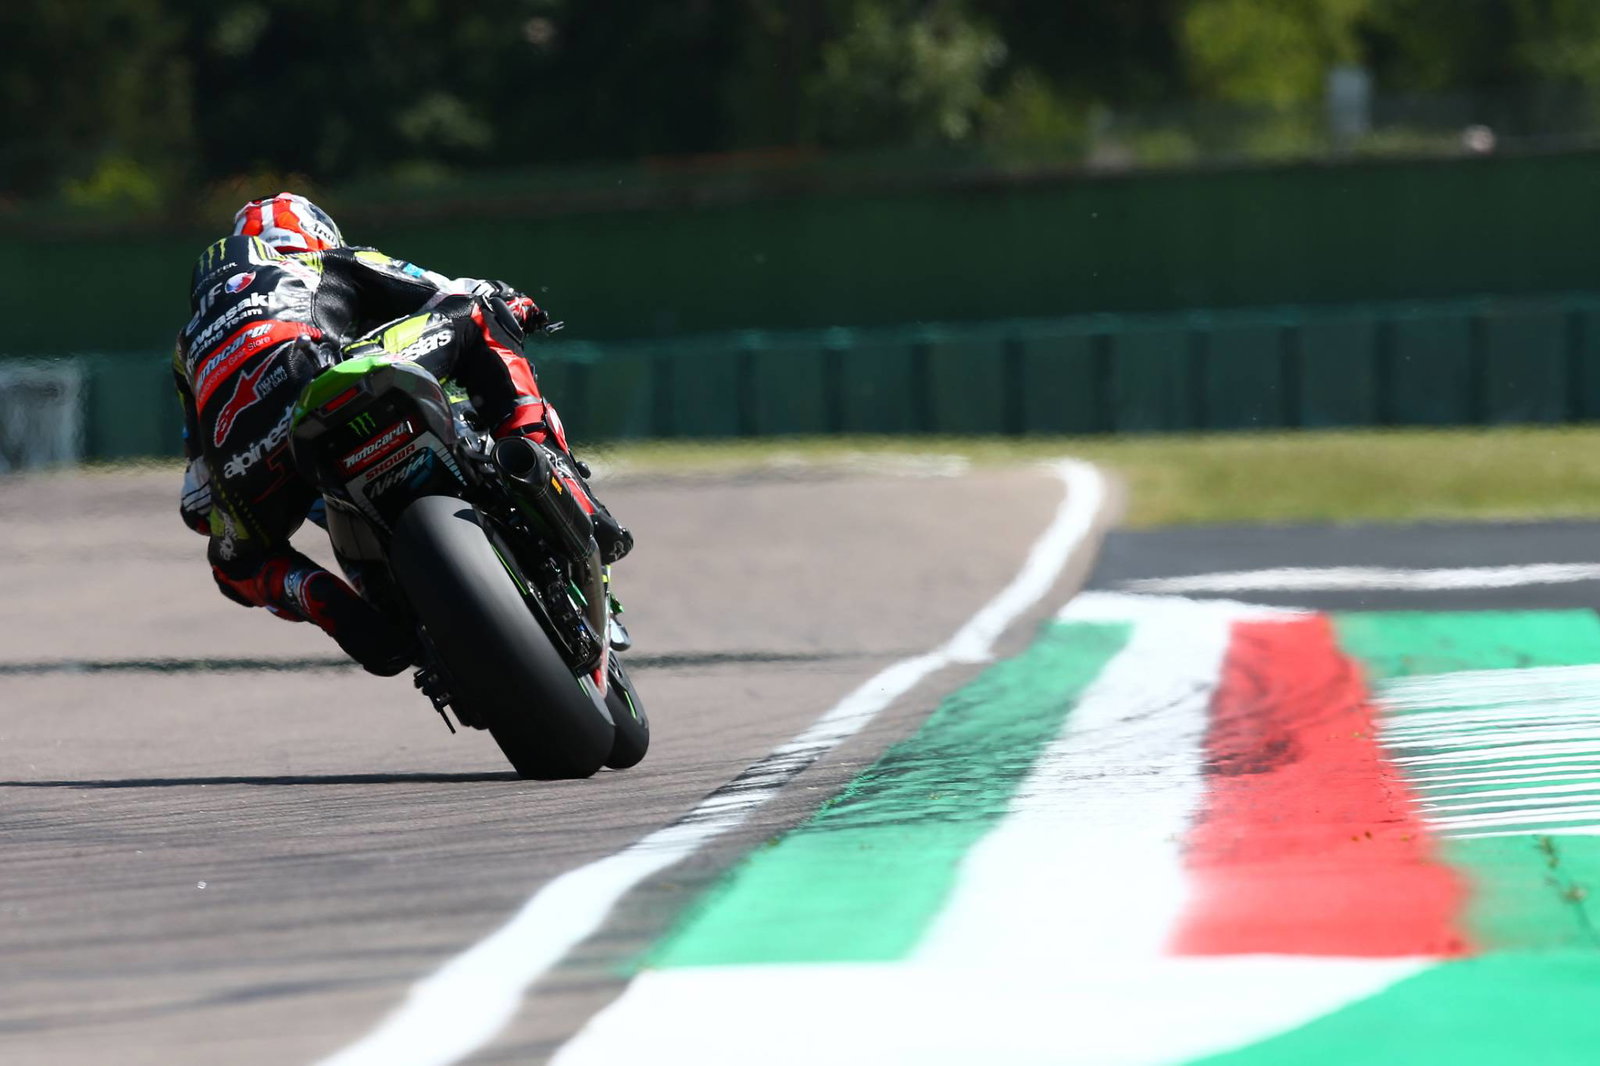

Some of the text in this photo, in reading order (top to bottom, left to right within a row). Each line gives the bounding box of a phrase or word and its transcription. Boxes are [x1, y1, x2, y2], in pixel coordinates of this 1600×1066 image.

[188, 291, 276, 358] awasaki
[248, 336, 271, 351] Store
[365, 443, 416, 481] SHOWA
[369, 454, 432, 499] Ninja
